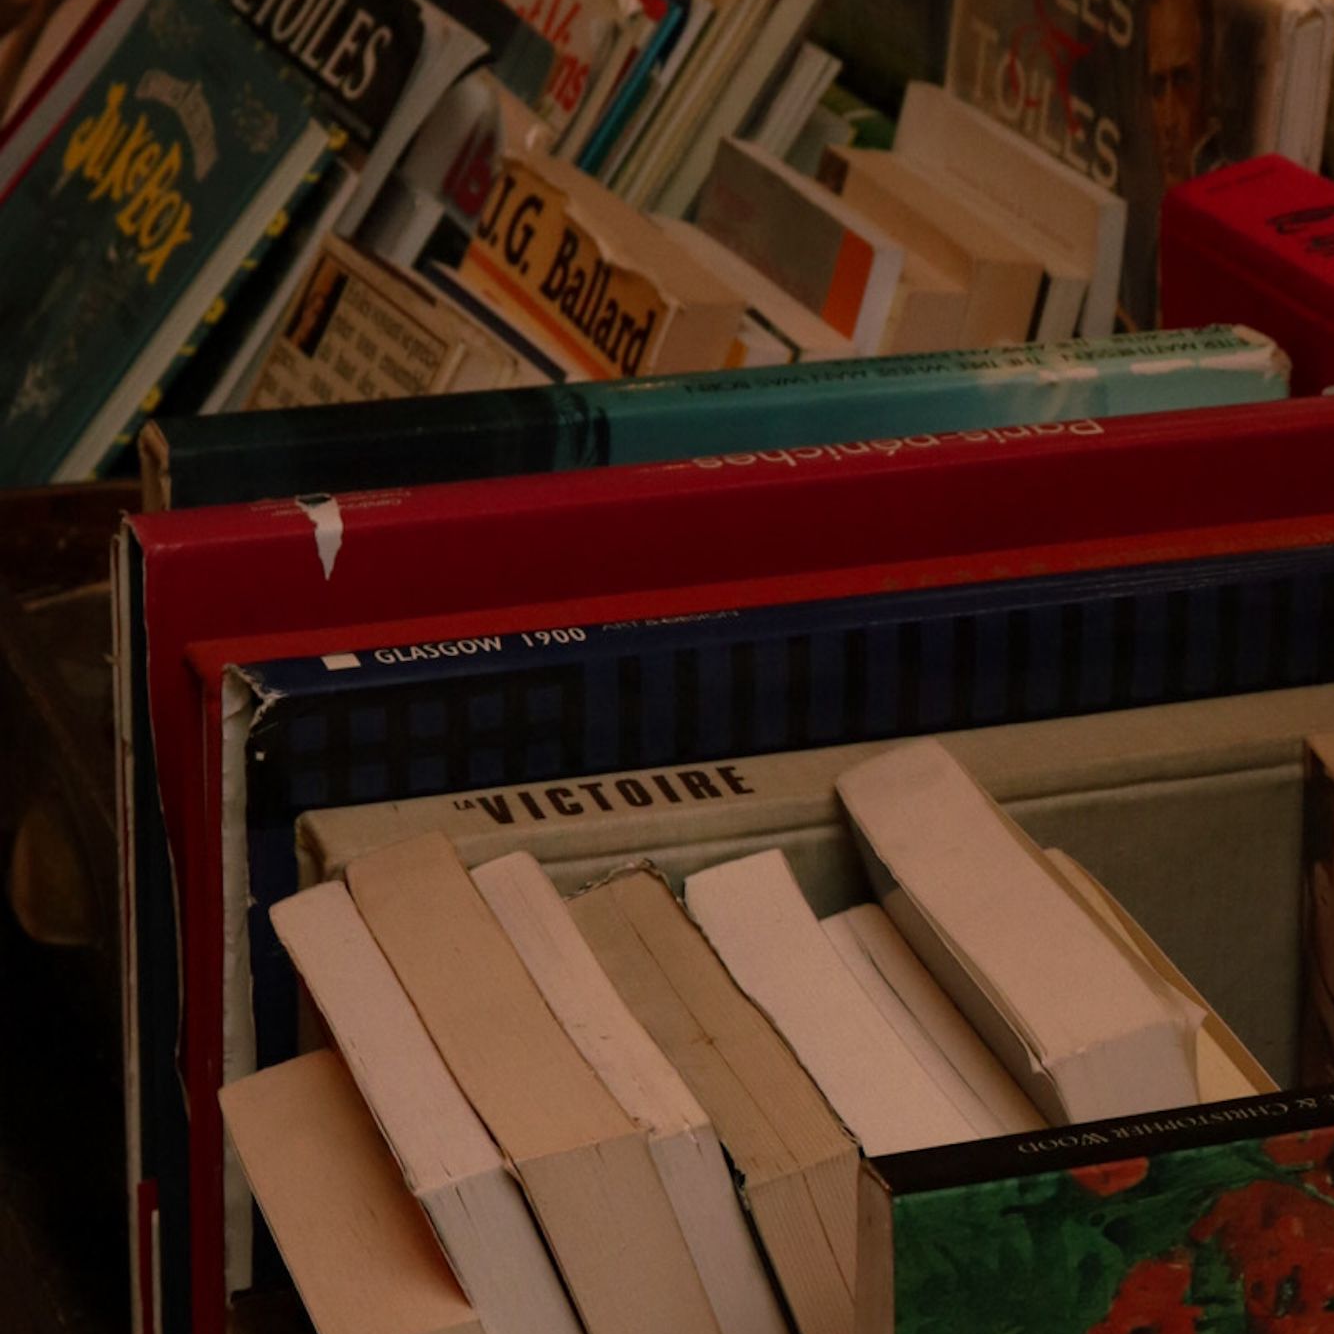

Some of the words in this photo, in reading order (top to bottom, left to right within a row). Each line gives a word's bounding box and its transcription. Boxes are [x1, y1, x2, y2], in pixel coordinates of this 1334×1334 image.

[540, 227, 657, 378] Ballard
[373, 634, 503, 666] GLASGOW
[520, 625, 588, 651] 1900
[476, 766, 756, 826] VICTOIRE
[1015, 1125, 1098, 1158] WOOD
[1099, 1096, 1288, 1144] CHRISTOPHER
